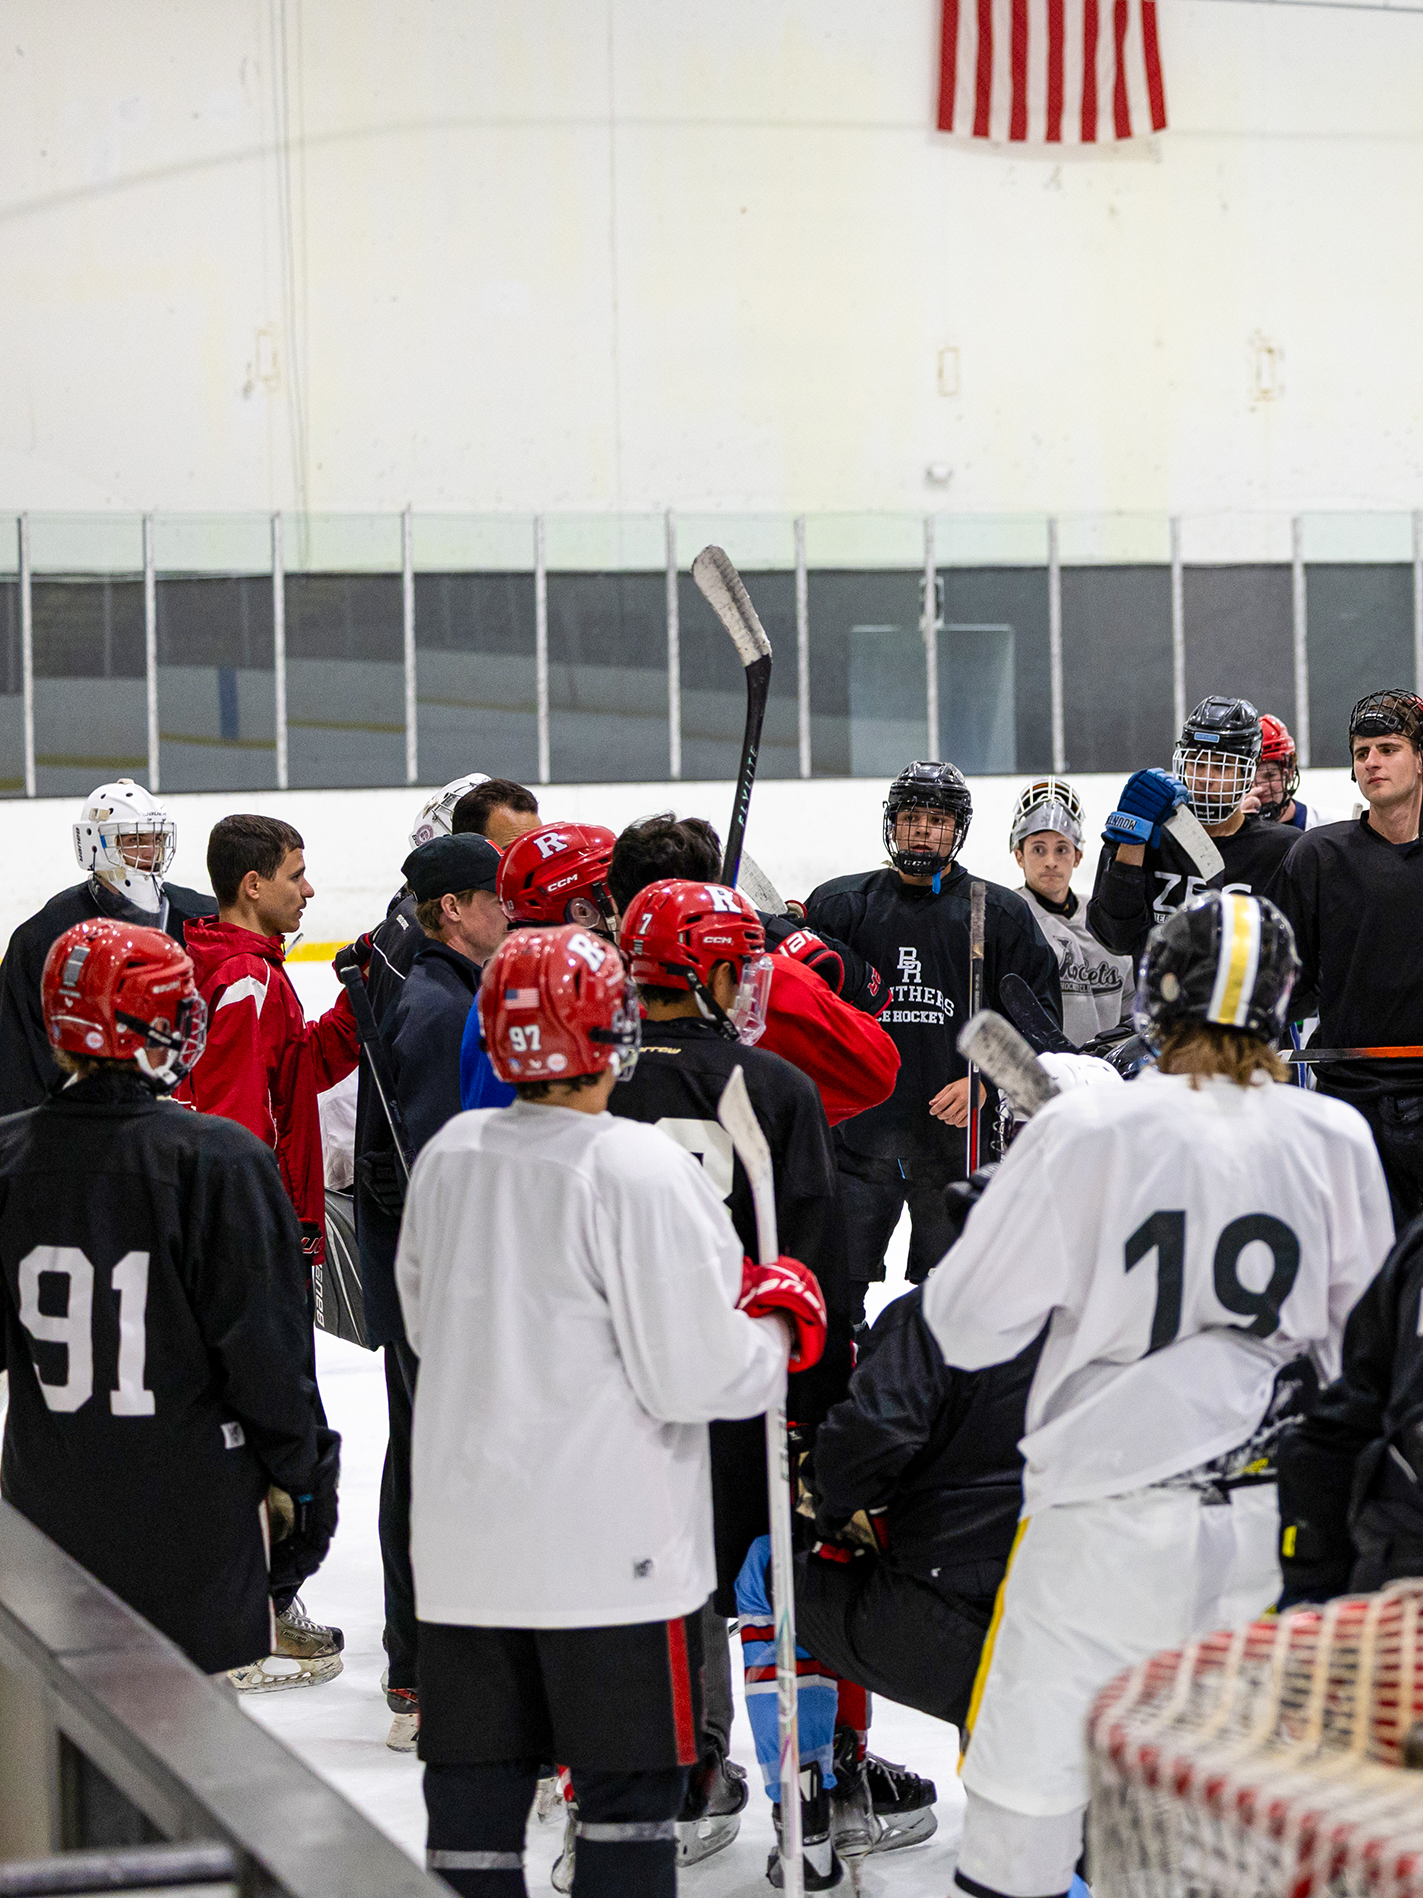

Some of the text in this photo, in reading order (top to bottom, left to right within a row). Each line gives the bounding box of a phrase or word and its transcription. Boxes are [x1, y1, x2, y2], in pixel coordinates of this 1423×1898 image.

[533, 831, 568, 860] R
[903, 859, 931, 868] CCM
[547, 873, 578, 894] CCM
[703, 884, 742, 914] R
[639, 913, 653, 935] 7
[703, 936, 733, 944] CCM
[888, 985, 955, 1018] NTHERS
[893, 1010, 945, 1025] HOCKEY
[509, 1024, 542, 1052] 97
[315, 1264, 325, 1328] BAUE
[1124, 1209, 1301, 1360] 19
[17, 1245, 156, 1416] 91
